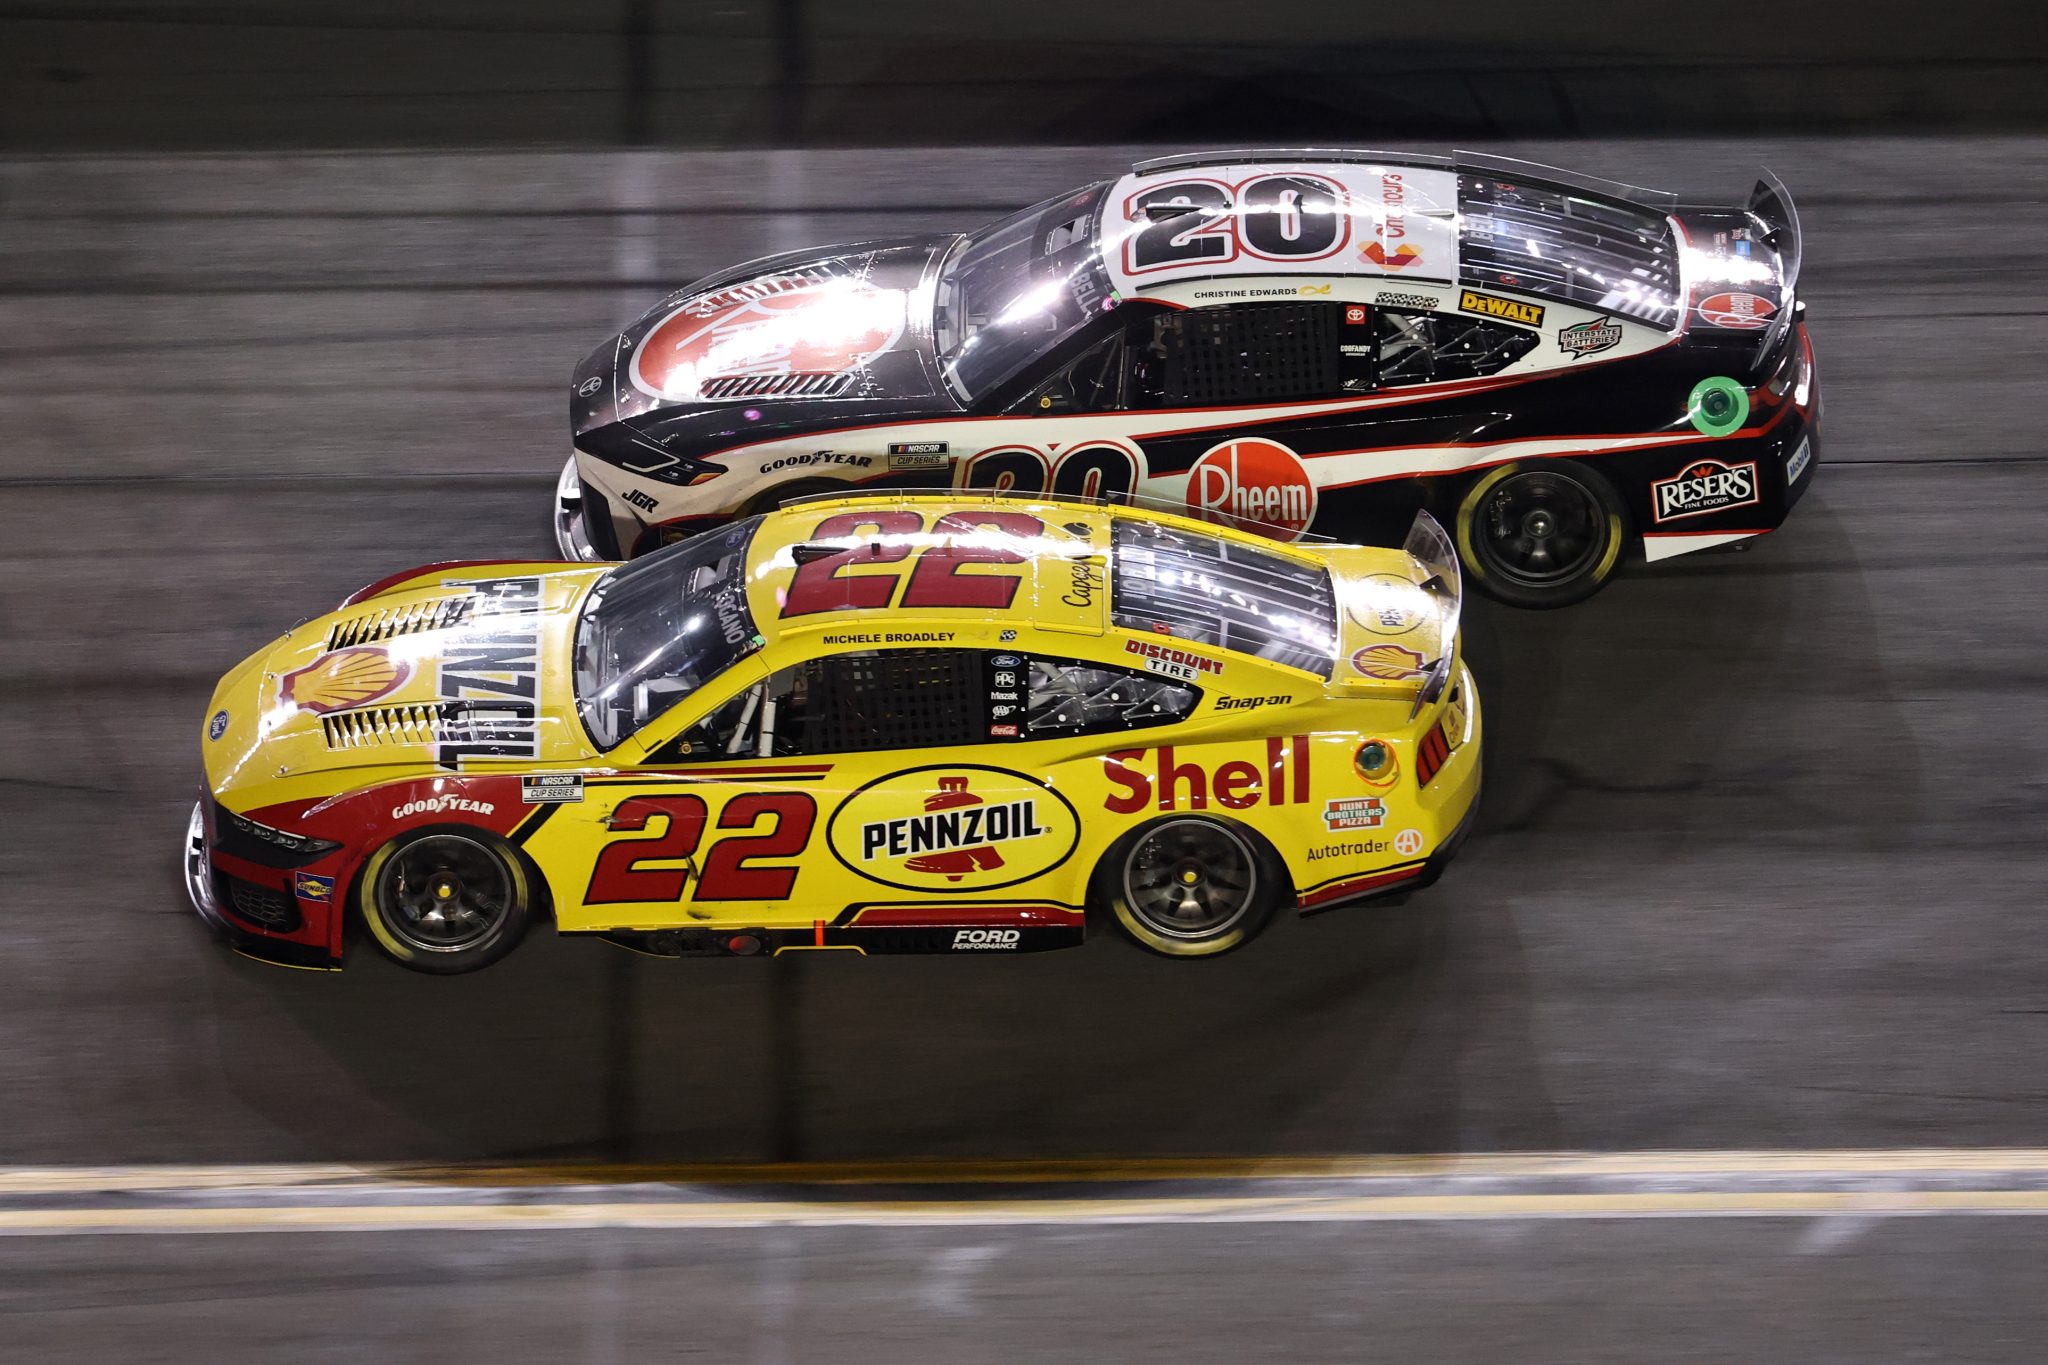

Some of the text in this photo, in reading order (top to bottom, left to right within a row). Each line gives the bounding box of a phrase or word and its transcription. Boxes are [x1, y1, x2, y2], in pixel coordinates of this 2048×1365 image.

[1376, 174, 1405, 238] Chmours
[1122, 172, 1351, 277] 20
[1069, 271, 1100, 313] BELL
[1194, 288, 1297, 299] CHRISTINE EDWARDS
[1563, 329, 1617, 340] INTERSTATE
[1566, 336, 1615, 348] BATTERIES
[908, 444, 940, 453] NASCAR
[897, 456, 941, 465] CUP SERIES
[1200, 444, 1307, 528] Rheem
[1660, 469, 1751, 516] RESER'S
[621, 489, 660, 514] JGR
[1684, 497, 1729, 510] FINE FOODS
[778, 510, 1045, 619] 22
[823, 632, 956, 645] MICHELE BROADLEY
[1125, 639, 1223, 675] DISCOUNT
[1150, 660, 1193, 679] TIRE
[996, 673, 1014, 685] PPG
[991, 691, 1018, 700] Mazak
[1214, 695, 1292, 710] Snap-on
[542, 776, 575, 786] NASCAR
[1103, 735, 1310, 814] Shell
[531, 788, 575, 797] CUP SERIES
[1338, 801, 1370, 811] HUNT
[1327, 808, 1383, 820] BROTHERS
[1338, 817, 1372, 827] PIZZA
[863, 800, 1043, 860] PENNZOIL
[583, 792, 818, 906] 22
[1306, 839, 1391, 863] Autotrader
[298, 882, 332, 893] SUNOCO
[953, 929, 1021, 943] FORD
